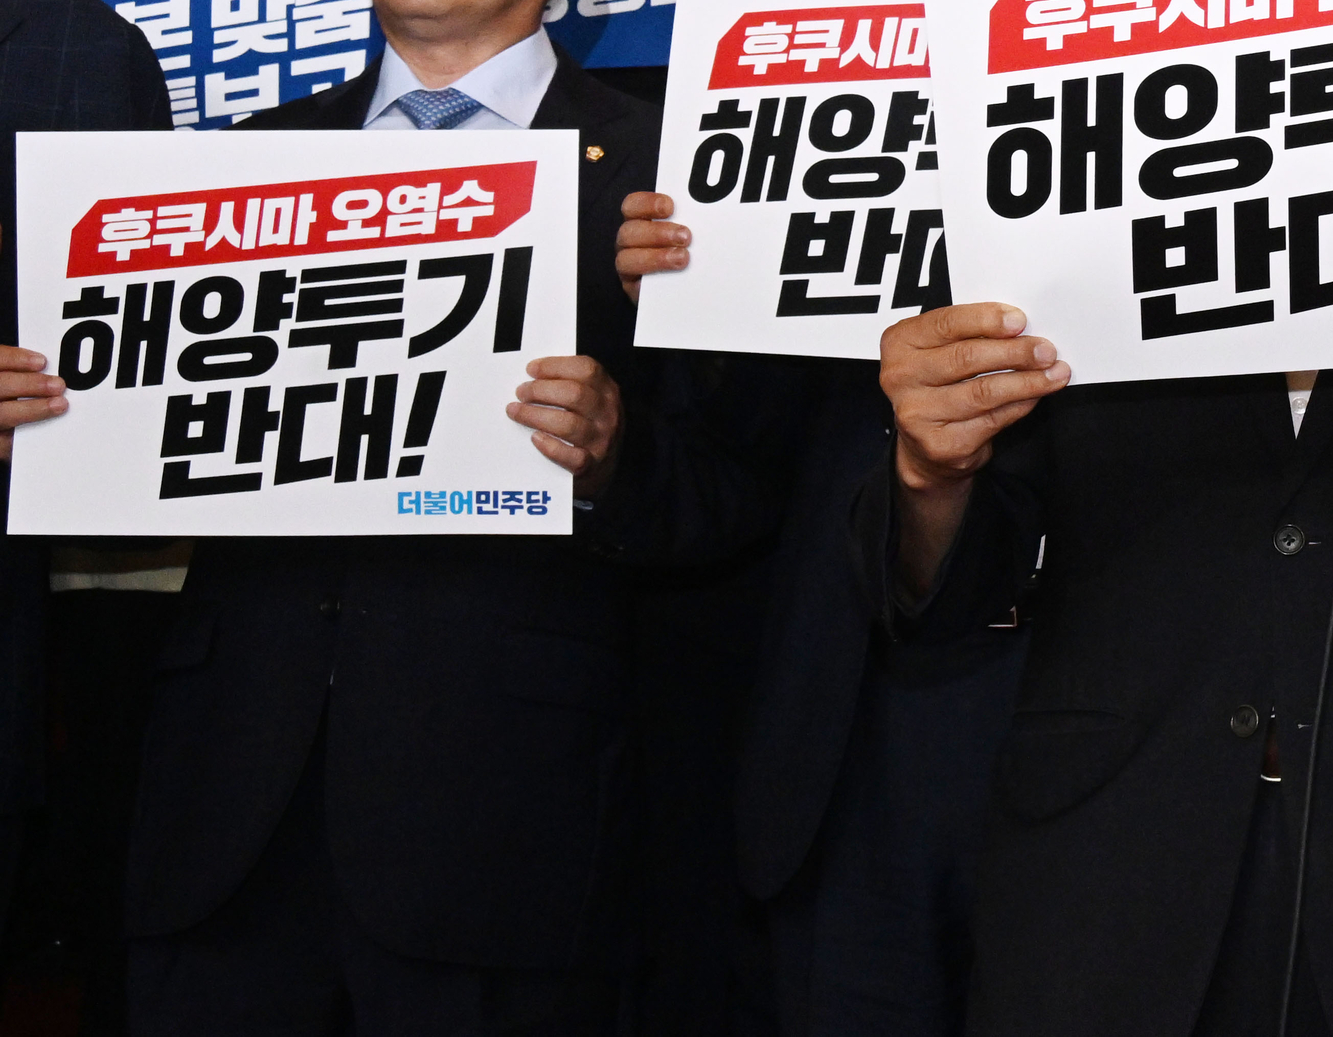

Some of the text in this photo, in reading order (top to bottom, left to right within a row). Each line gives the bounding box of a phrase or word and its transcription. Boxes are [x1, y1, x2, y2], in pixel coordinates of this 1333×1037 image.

[687, 90, 938, 204] 해양
[97, 179, 496, 262] 후쿠시마 오염수
[59, 245, 534, 392] 해양투기
[158, 370, 448, 500] 반대!
[397, 489, 552, 517] 더불어민주당
